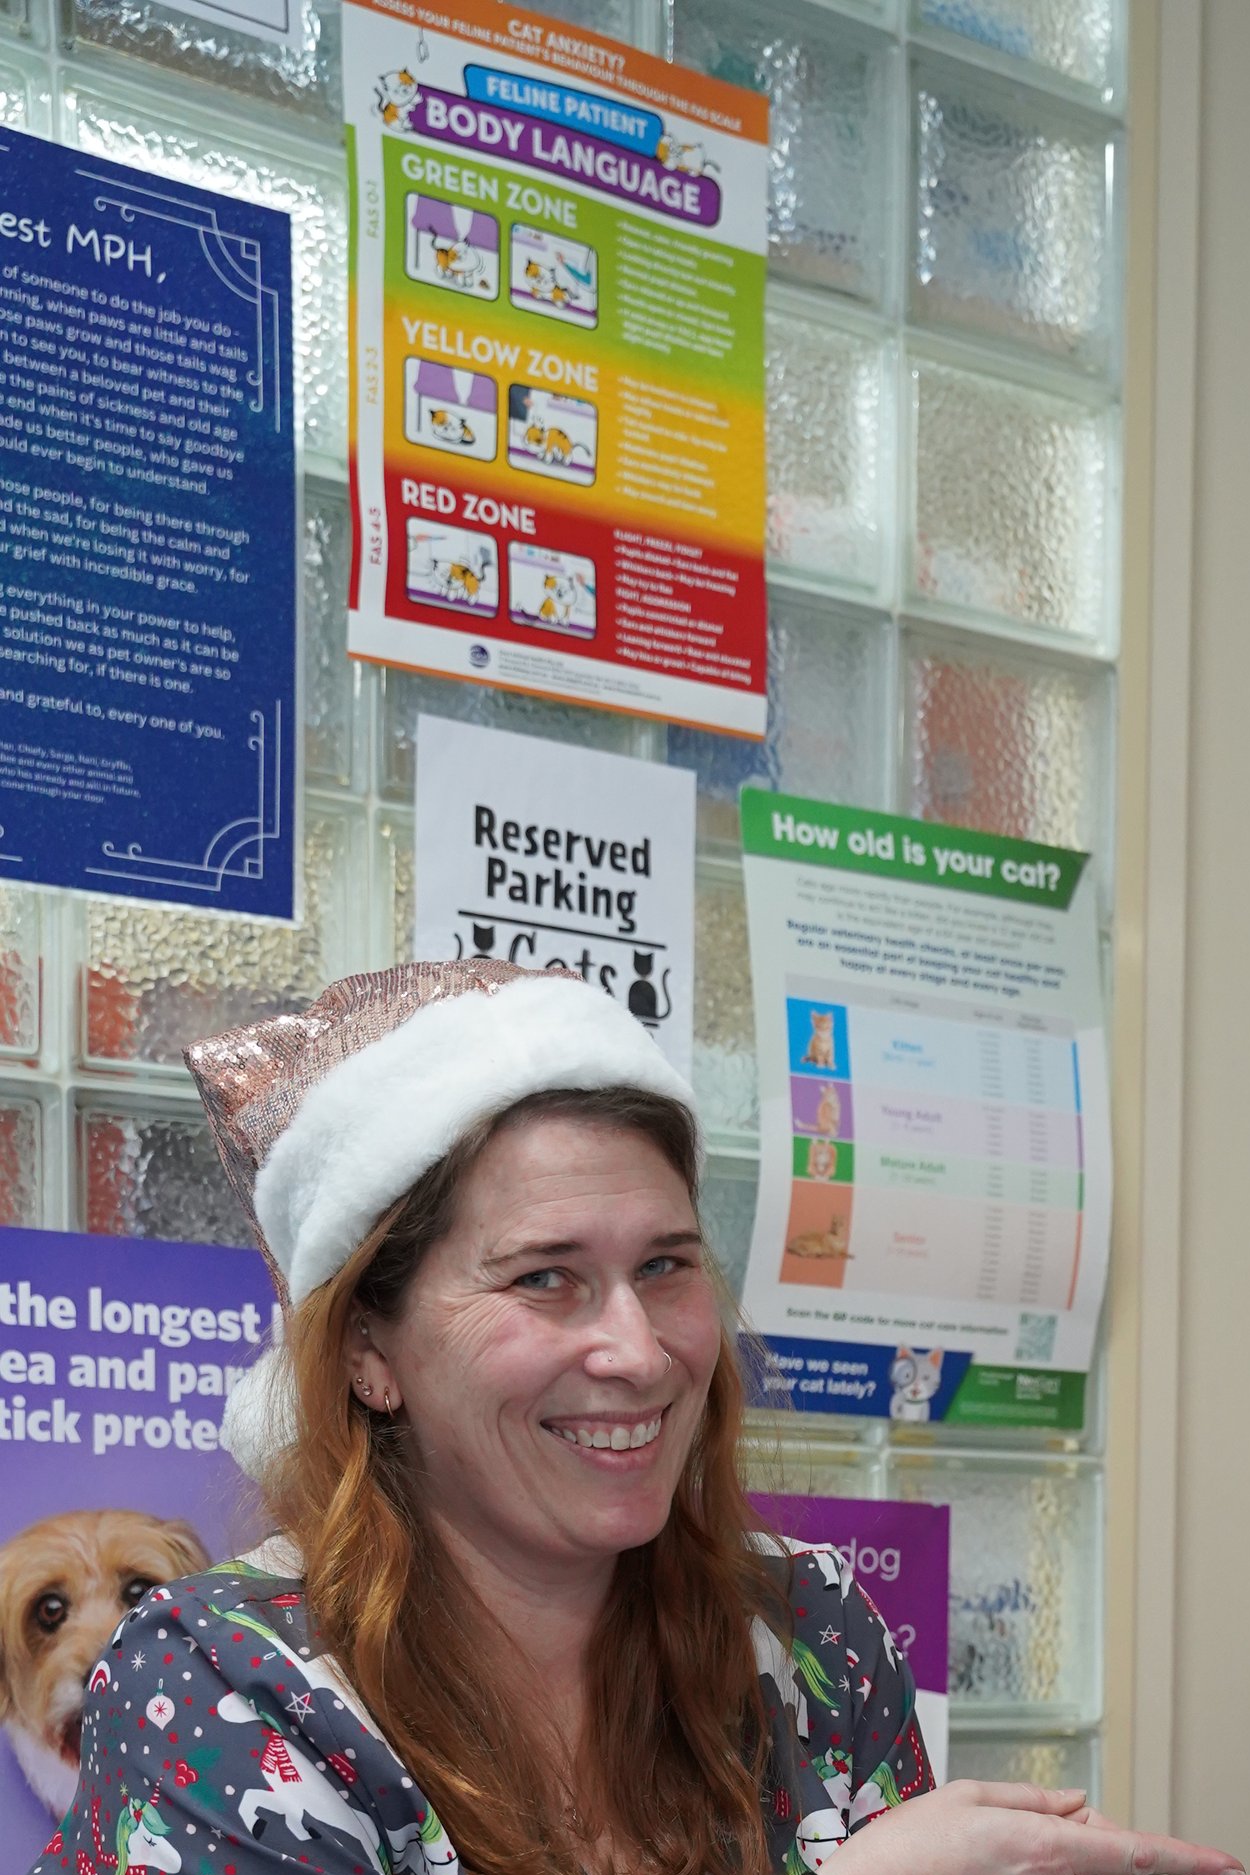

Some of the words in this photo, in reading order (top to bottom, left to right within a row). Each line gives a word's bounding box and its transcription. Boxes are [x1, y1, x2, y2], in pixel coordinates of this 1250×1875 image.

[416, 9, 450, 28] YOUR
[452, 19, 491, 40] FELINE
[508, 19, 543, 44] CAT
[546, 33, 625, 72] ANXIETY?
[486, 76, 560, 113] FELINE
[565, 96, 648, 139] PATIENT
[426, 97, 524, 151] BODY
[532, 128, 701, 216] LANGUAGE
[401, 153, 499, 202] GREEN
[505, 182, 578, 228] ZONE
[66, 223, 167, 284] MPH,
[2, 265, 19, 280] of
[21, 271, 89, 300] someone
[90, 289, 108, 305] to
[109, 294, 130, 311] do
[131, 300, 156, 318] the
[157, 307, 182, 325] job
[182, 316, 210, 333] you
[211, 321, 232, 338] do
[46, 299, 86, 320] when
[88, 311, 126, 331] paws
[127, 322, 152, 338] are
[154, 325, 188, 347] little
[189, 337, 217, 355] and
[218, 343, 249, 363] tails
[401, 315, 521, 369] YELLOW
[527, 349, 599, 393] ZONE
[2, 348, 67, 378] between
[81, 369, 140, 397] beloved
[141, 387, 166, 404] pet
[168, 394, 196, 411] and
[197, 399, 230, 418] their
[11, 330, 29, 347] to
[30, 337, 57, 355] see
[92, 352, 110, 369] to
[111, 356, 144, 376] bear
[147, 368, 200, 392] witness
[201, 380, 218, 396] to
[219, 384, 244, 402] the
[6, 395, 36, 413] end
[38, 404, 78, 423] when
[104, 418, 138, 438] time
[138, 426, 156, 442] to
[157, 432, 182, 451] say
[183, 438, 245, 464] goodbye
[30, 444, 64, 461] ever
[65, 449, 106, 472] begin
[107, 460, 125, 476] to
[15, 502, 41, 519] the
[75, 514, 98, 531] for
[99, 519, 140, 545] being
[141, 530, 166, 547] the
[167, 537, 202, 554] calm
[203, 544, 231, 560] and
[89, 496, 111, 514] for
[113, 502, 154, 527] being
[154, 512, 193, 533] there
[194, 521, 250, 546] through
[401, 478, 457, 514] RED
[462, 493, 536, 536] ZONE
[12, 544, 48, 562] grief
[49, 552, 81, 569] with
[83, 557, 155, 585] incredible
[5, 585, 85, 615] everything
[85, 598, 100, 614] in
[102, 605, 136, 621] your
[137, 612, 181, 630] power
[183, 619, 200, 635] to
[0, 645, 67, 673] searching
[95, 663, 107, 677] if
[108, 666, 147, 685] there
[148, 673, 162, 688] is
[3, 626, 62, 648] solution
[64, 639, 86, 653] we
[87, 643, 105, 657] as
[106, 647, 131, 662] pet
[189, 663, 213, 677] are
[214, 667, 232, 681] so
[26, 693, 84, 715] grateful
[107, 708, 148, 729] every
[149, 716, 177, 731] one
[177, 720, 194, 733] of
[473, 804, 651, 878] Reserved
[771, 811, 840, 850] How
[848, 830, 895, 861] old
[902, 836, 927, 866] is
[932, 847, 995, 879] your
[1001, 858, 1061, 892] cat?
[486, 856, 637, 933] Parking
[0, 1280, 77, 1330] the
[88, 1286, 261, 1348] longest
[68, 1347, 156, 1392] and
[799, 1378, 824, 1393] cat
[826, 1377, 877, 1400] lately?
[806, 1359, 829, 1373] we
[831, 1360, 869, 1376] seen
[838, 1537, 901, 1582] dog
